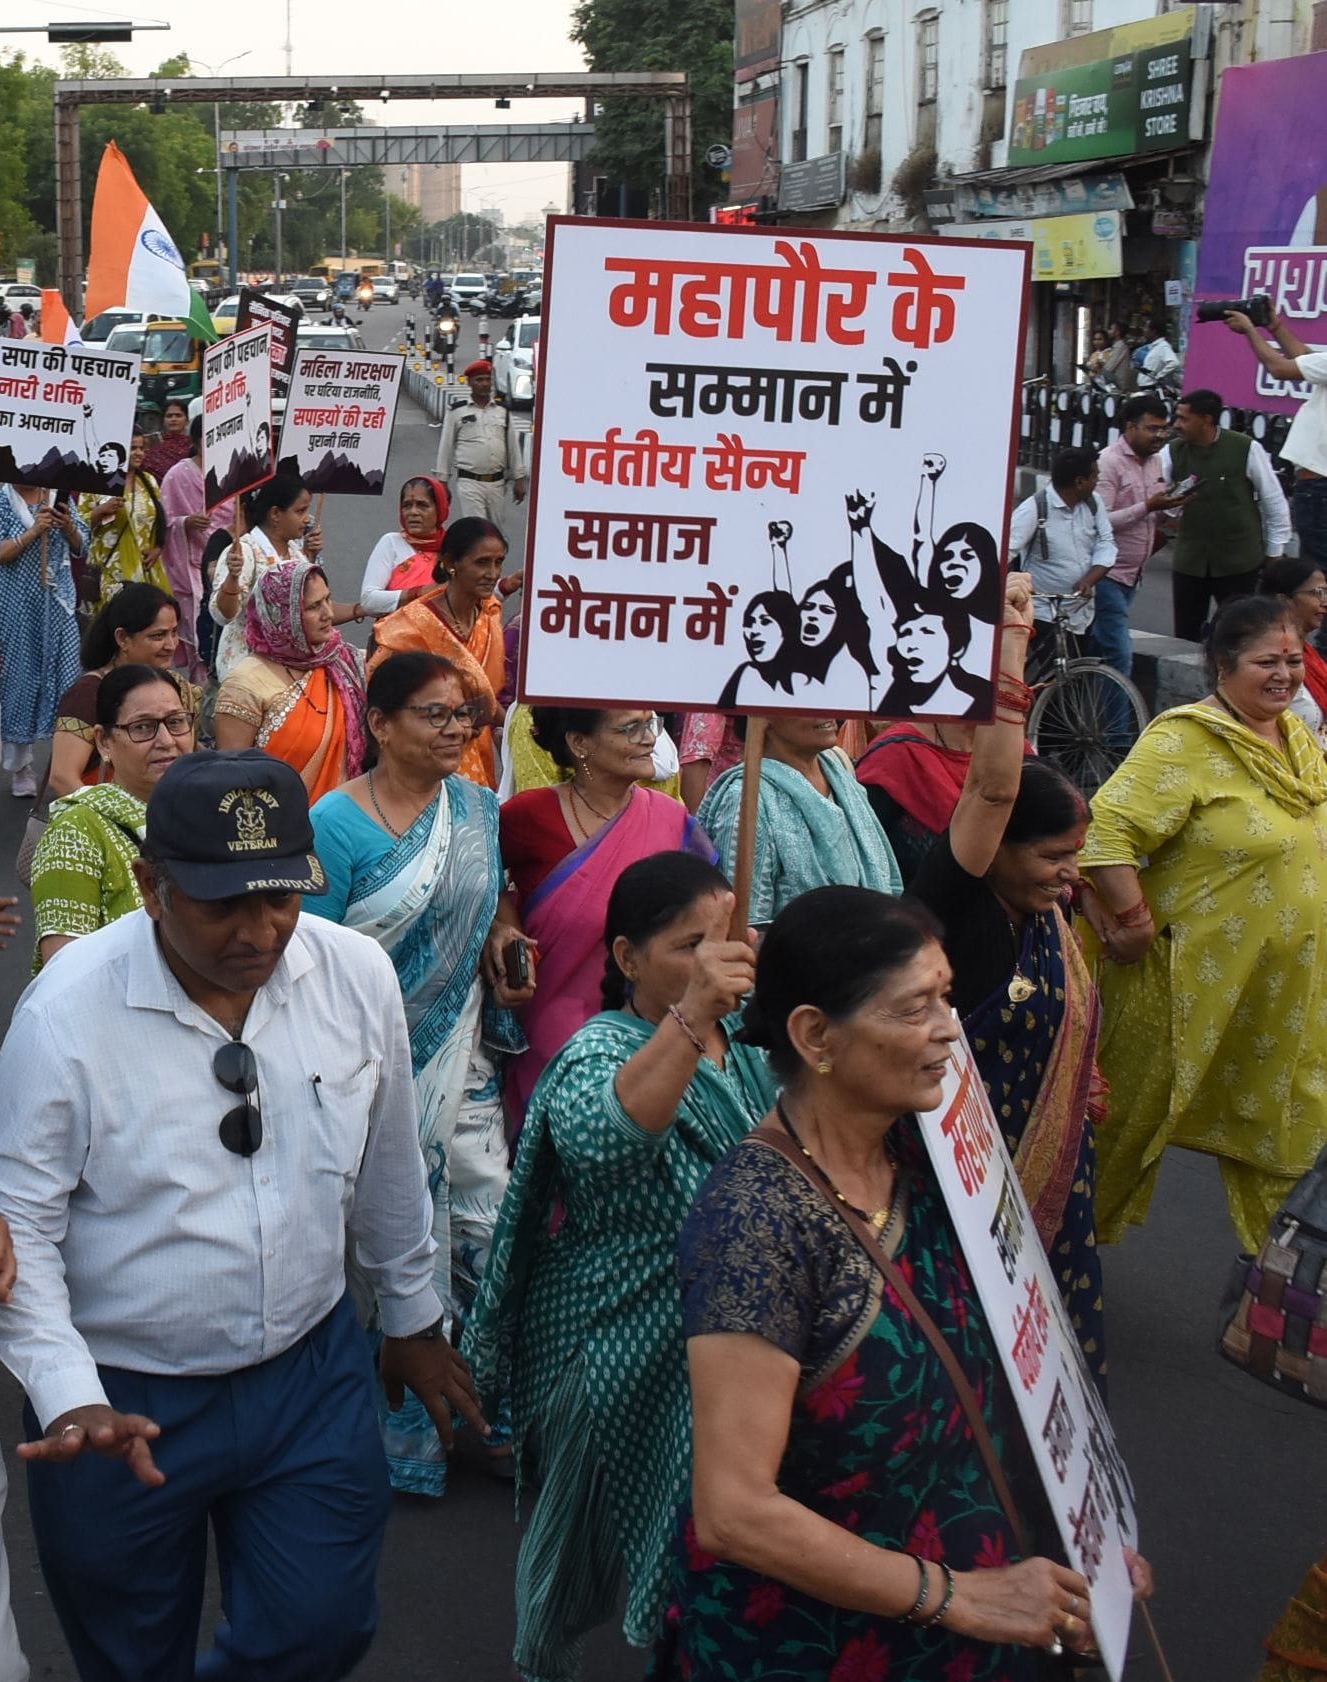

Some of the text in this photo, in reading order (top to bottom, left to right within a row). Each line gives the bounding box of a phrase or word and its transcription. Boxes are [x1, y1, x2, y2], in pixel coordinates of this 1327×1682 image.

[1147, 55, 1179, 80] SHREE
[1140, 83, 1184, 110] KRISHNA
[1145, 113, 1177, 137] STORE
[604, 240, 966, 349] महापौर के
[1, 346, 137, 384] सपा की पहचान,
[207, 355, 222, 380] सपा
[223, 340, 235, 371] की
[237, 333, 270, 364] पहचान,
[300, 355, 343, 379] महिला
[344, 362, 398, 382] आरक्षण
[43, 380, 86, 405] शक्ति
[205, 380, 223, 416] नारी
[225, 371, 246, 405] शक्ति
[304, 381, 382, 402] पर घटिया राजनीति,
[645, 356, 918, 429] सम्मान में
[18, 413, 76, 435] अपमान
[293, 404, 386, 429] सपाइयों की रही
[205, 413, 244, 449] का अपमान
[308, 432, 362, 451] पुरानी निति
[558, 427, 807, 494] पर्वतीय सैन्य
[563, 509, 718, 565] समाज
[537, 574, 740, 646] मैदान में
[227, 837, 278, 852] VETERAN
[246, 879, 318, 890] PROUDLY
